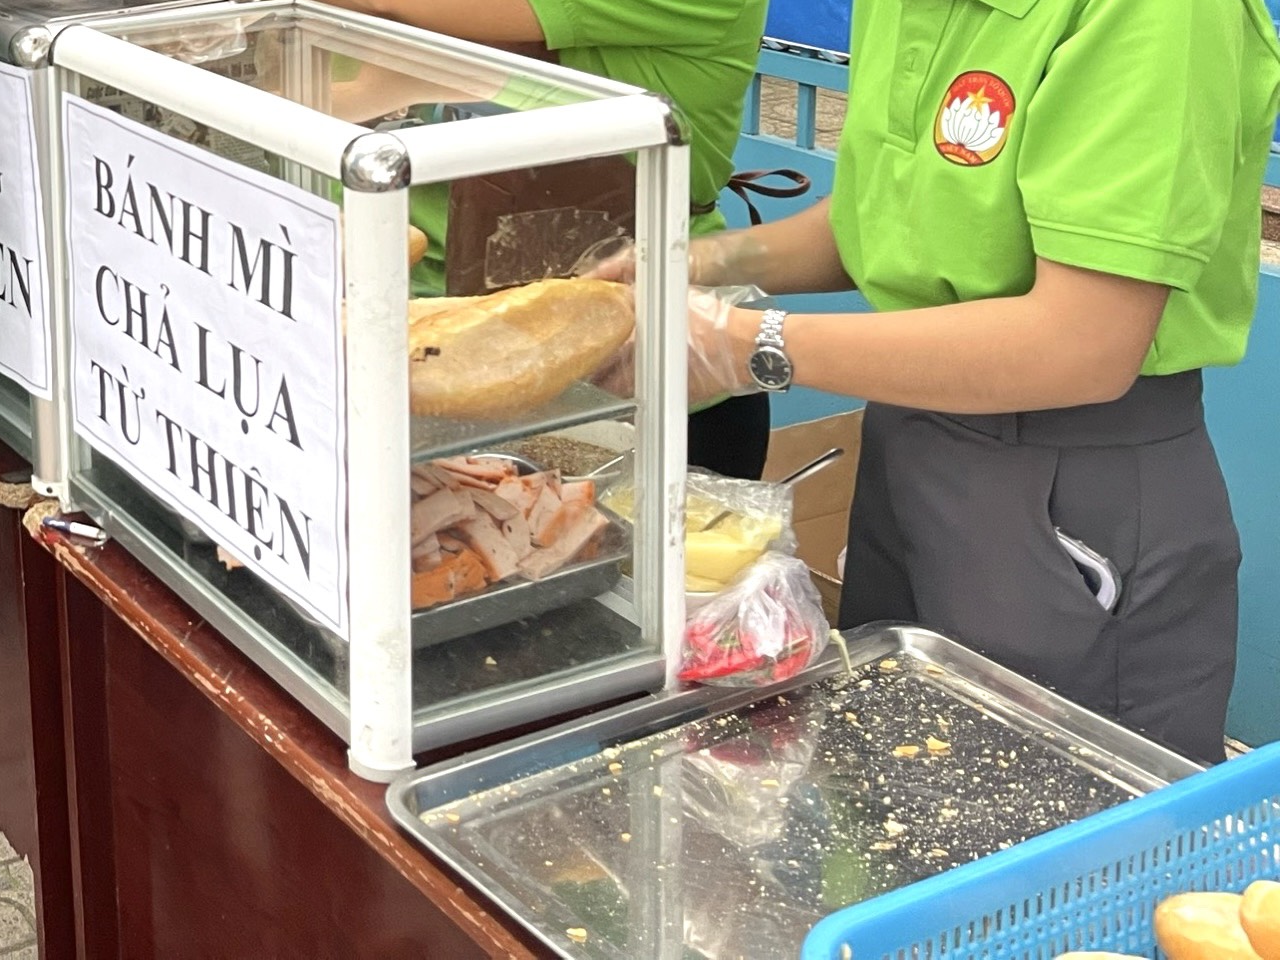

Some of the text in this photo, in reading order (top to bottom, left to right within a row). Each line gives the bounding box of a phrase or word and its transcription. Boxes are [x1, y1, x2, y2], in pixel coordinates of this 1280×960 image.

[93, 153, 299, 323] BÁNH MÌ
[95, 264, 305, 452] CHẢ LỤA
[90, 358, 313, 583] TỪ THIỆN
